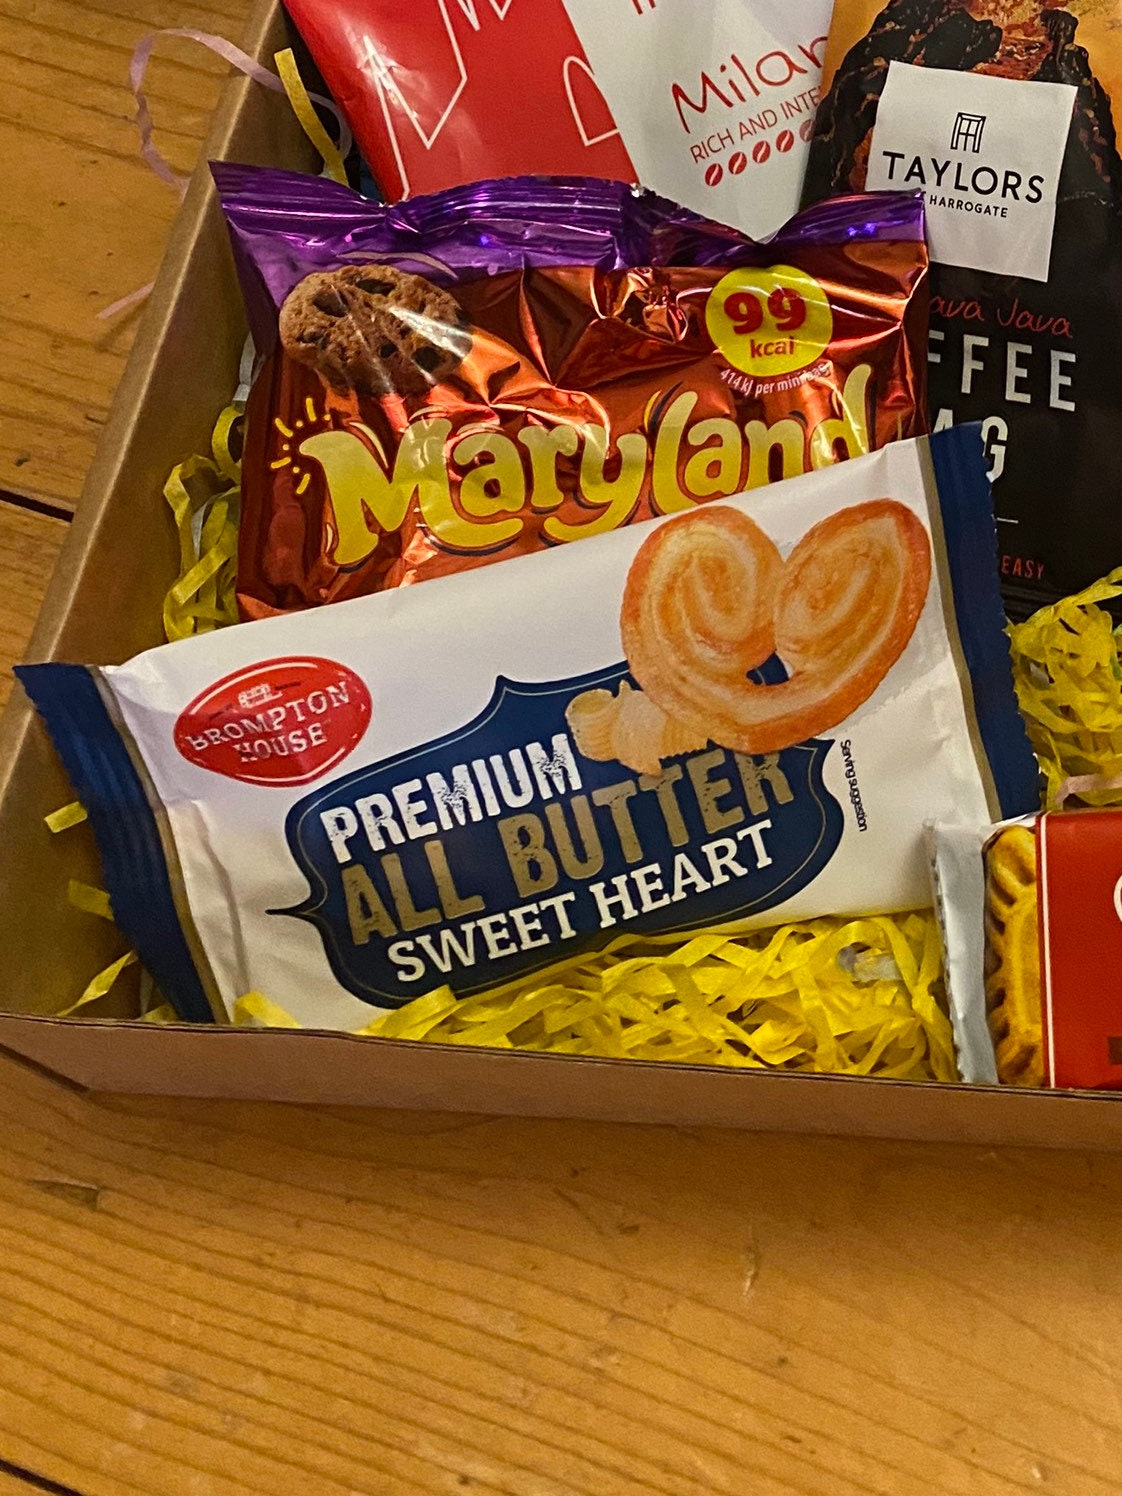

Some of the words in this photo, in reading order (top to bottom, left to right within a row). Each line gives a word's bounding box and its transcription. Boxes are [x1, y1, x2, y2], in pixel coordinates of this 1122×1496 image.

[690, 128, 735, 163] RICH
[738, 109, 777, 140] AND
[780, 86, 820, 119] INTE
[882, 151, 1044, 203] TAYLORS
[929, 194, 1008, 218] HARROGATE
[723, 287, 806, 335] 99
[930, 296, 984, 321] ava
[997, 297, 1074, 338] Java
[750, 336, 795, 358] kcal
[928, 329, 1076, 412] FEE
[754, 382, 775, 398] per
[299, 363, 872, 566] Maryland
[1001, 555, 1044, 579] EASY
[185, 681, 350, 751] BROMPTON
[233, 722, 328, 763] HOUSE
[319, 733, 583, 864] PREMIUM
[339, 840, 484, 947] ALL
[496, 748, 796, 899] BUTTER
[387, 891, 577, 983] SWEET
[588, 819, 774, 928] HEART
